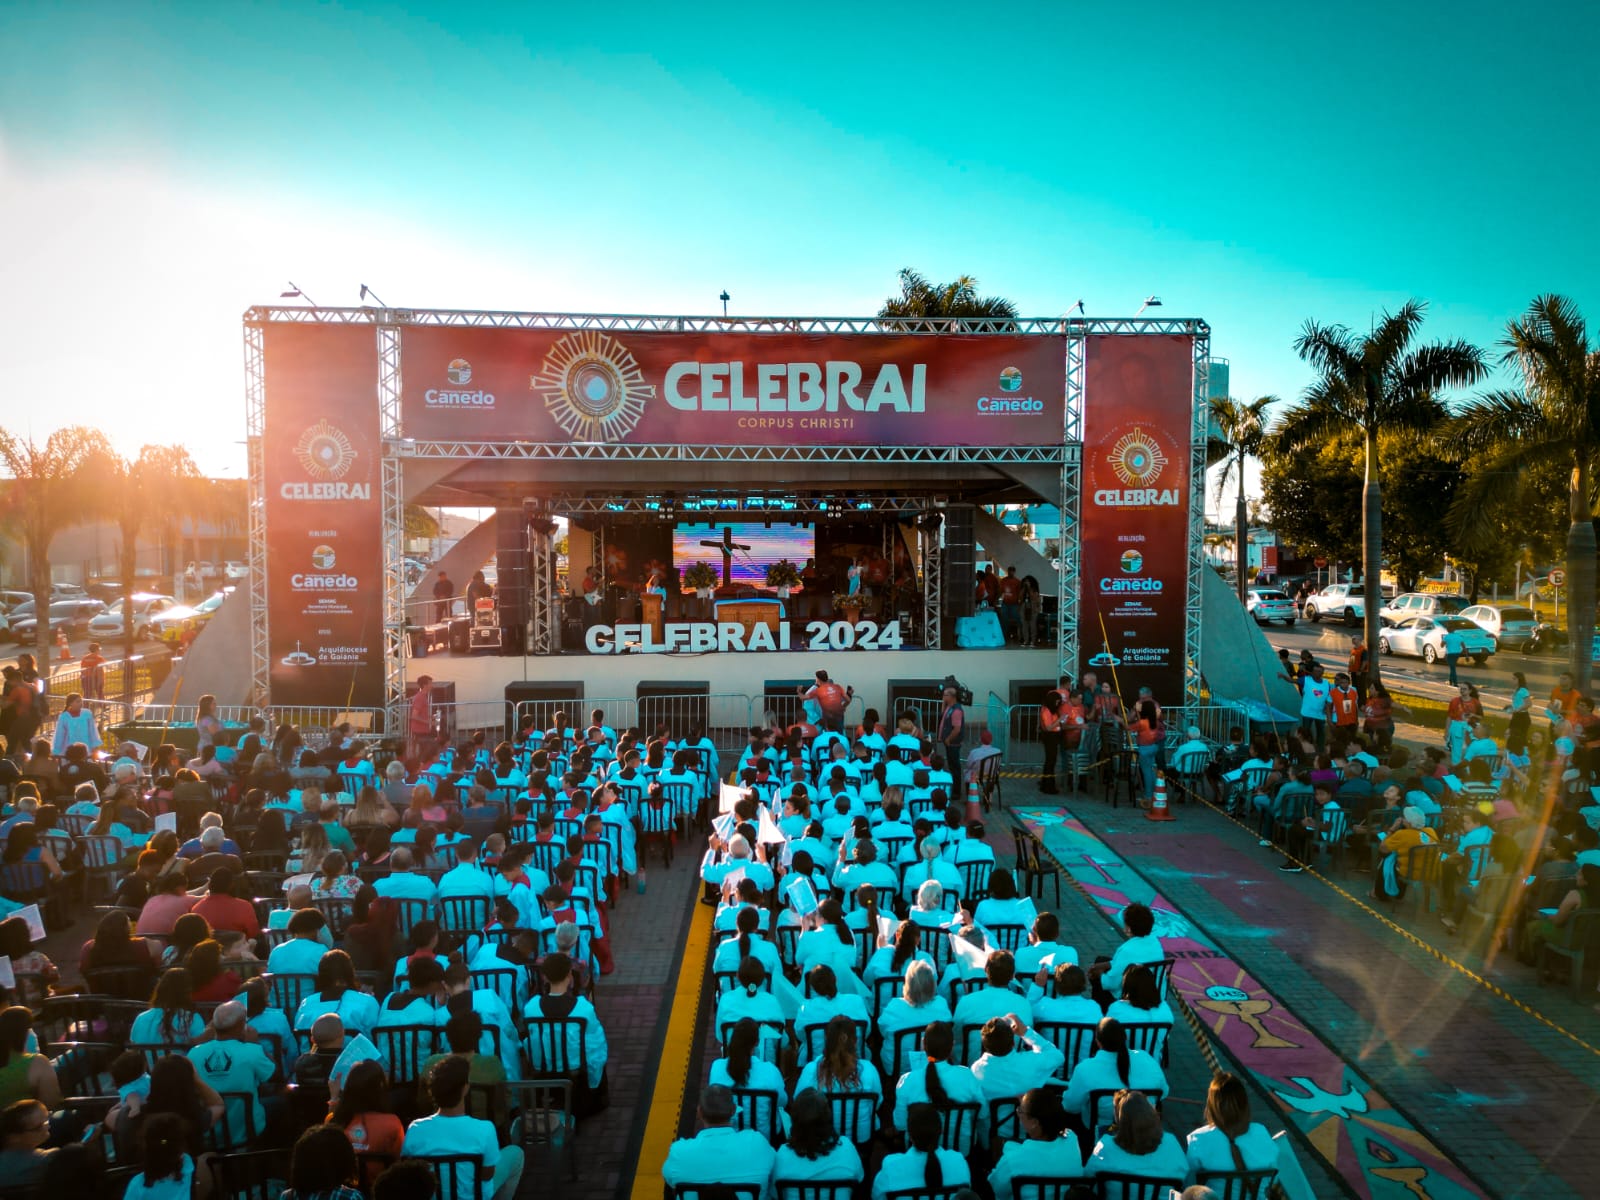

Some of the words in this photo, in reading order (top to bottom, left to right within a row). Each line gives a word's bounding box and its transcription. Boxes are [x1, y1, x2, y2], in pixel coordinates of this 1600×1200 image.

[663, 361, 927, 412] CELEBRAI
[425, 389, 495, 405] Canedo
[977, 397, 1044, 411] Canedo
[738, 417, 794, 429] CORPUS
[800, 417, 854, 429] CHRISTI
[280, 482, 370, 500] CELEBRAI
[1094, 489, 1179, 506] CELEBRAI
[291, 573, 358, 588] Canedo
[1100, 578, 1163, 591] Canedo
[585, 621, 790, 654] CELEBRAI
[805, 621, 903, 650] 2024
[319, 646, 368, 655] Arquidiocese
[1123, 647, 1169, 656] Arquidiocese
